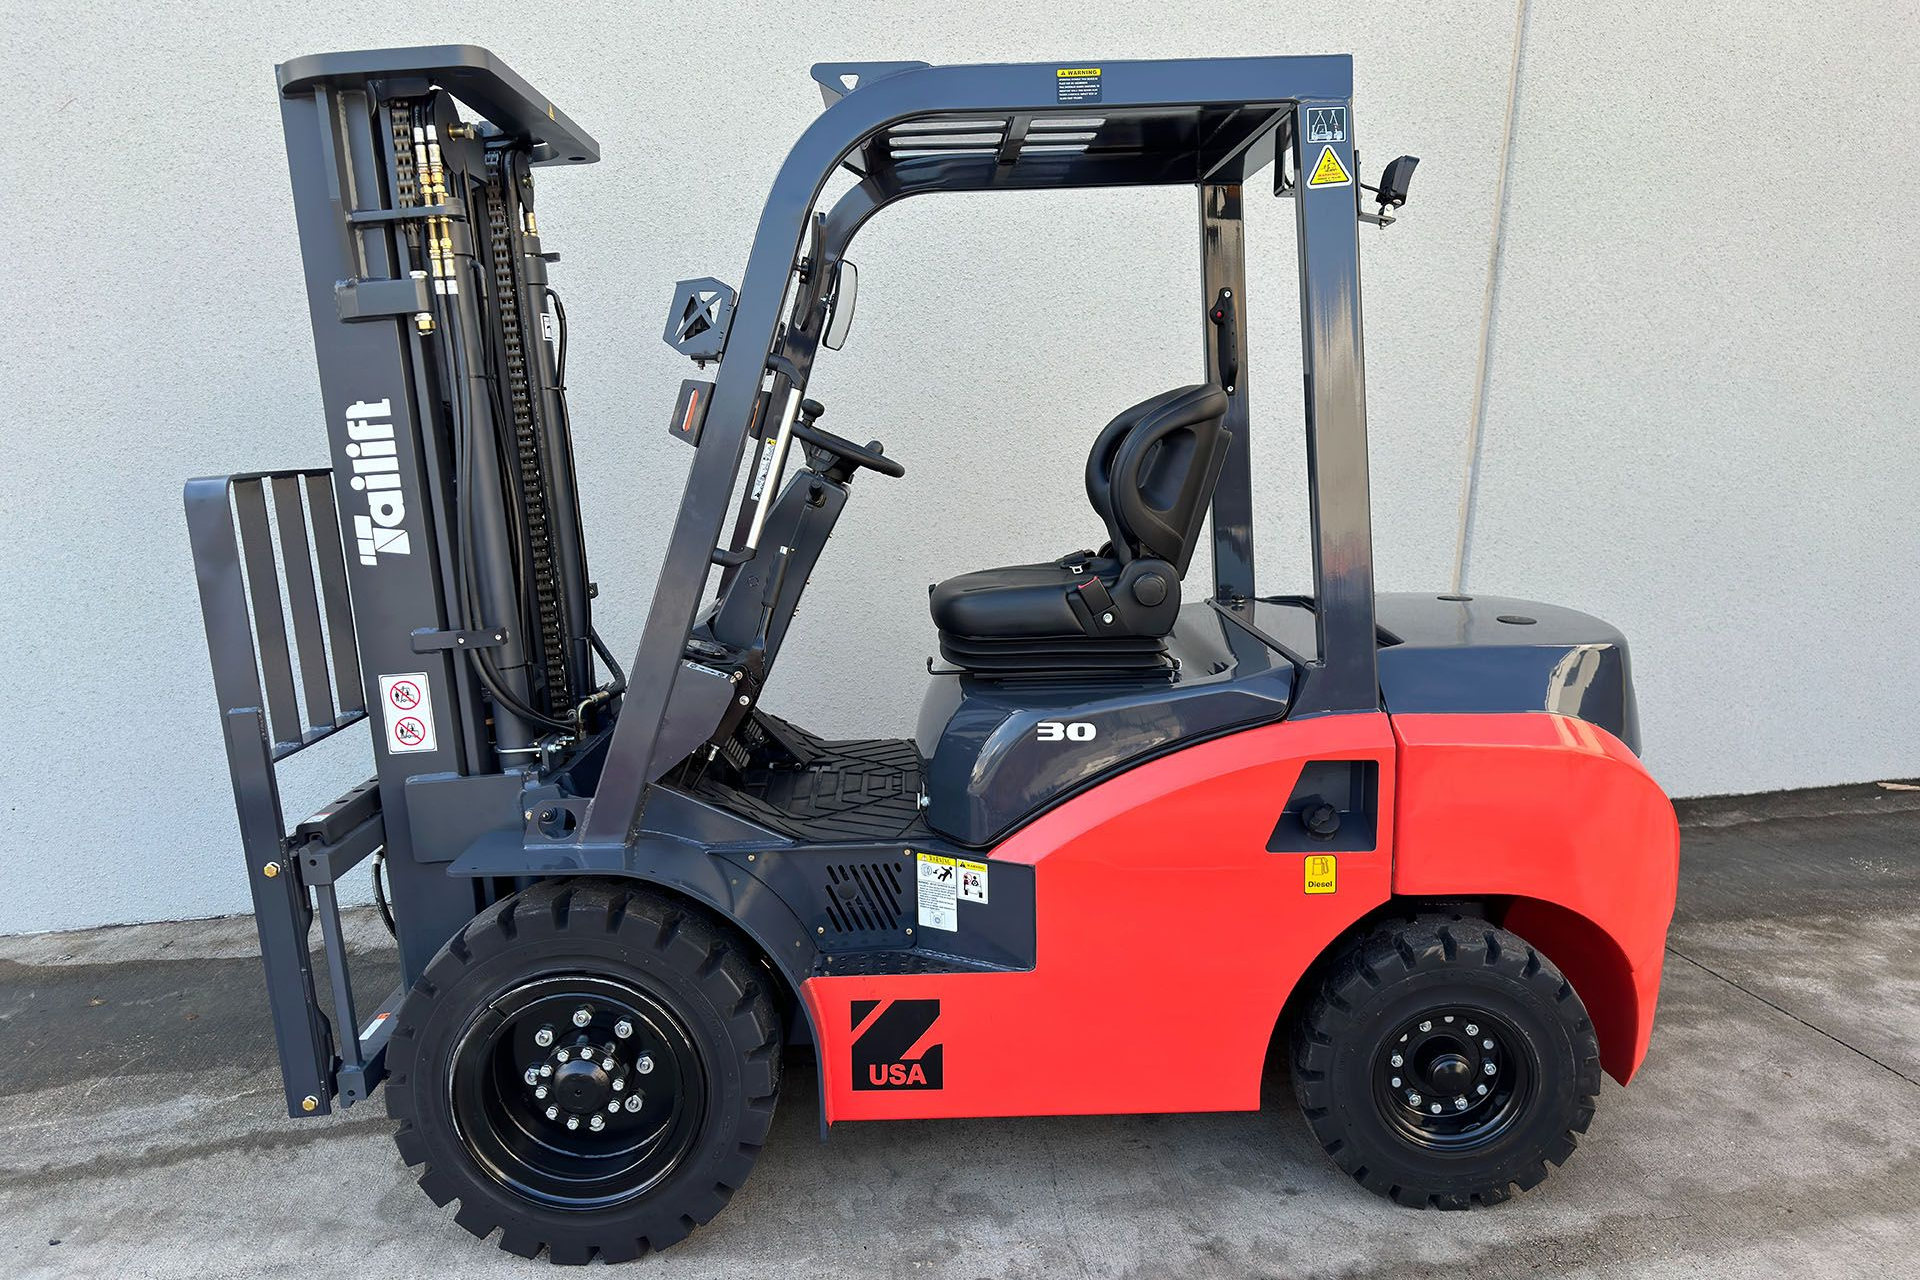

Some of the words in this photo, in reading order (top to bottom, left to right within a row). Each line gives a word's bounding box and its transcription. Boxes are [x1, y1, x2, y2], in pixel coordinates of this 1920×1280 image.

[345, 398, 411, 566] Tailift
[1037, 722, 1096, 741] 30
[869, 1063, 928, 1086] USA
